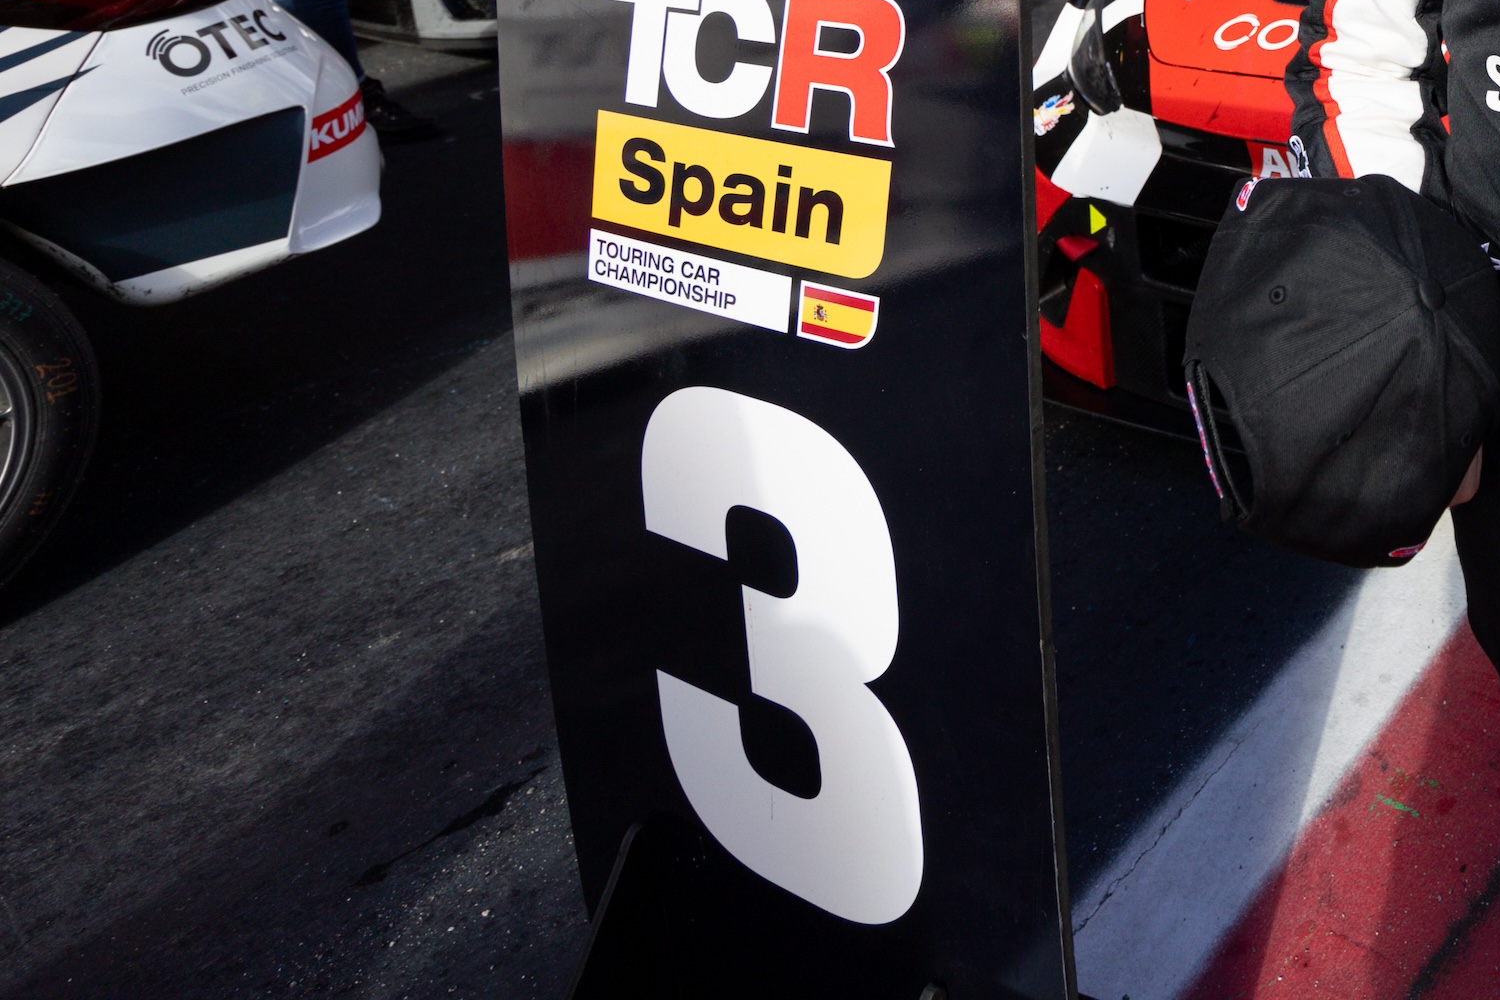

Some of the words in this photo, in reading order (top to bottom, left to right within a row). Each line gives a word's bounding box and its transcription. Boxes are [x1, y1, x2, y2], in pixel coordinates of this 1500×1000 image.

[158, 9, 287, 77] OTEC
[180, 71, 231, 96] PRECISION
[231, 55, 271, 76] FINISHING
[310, 101, 365, 151] KUM
[618, 136, 845, 246] Spain
[594, 259, 738, 311] CHAMPIONSHIP
[596, 239, 675, 275] TOURING
[681, 259, 721, 286] CAR
[641, 385, 925, 926] 3
